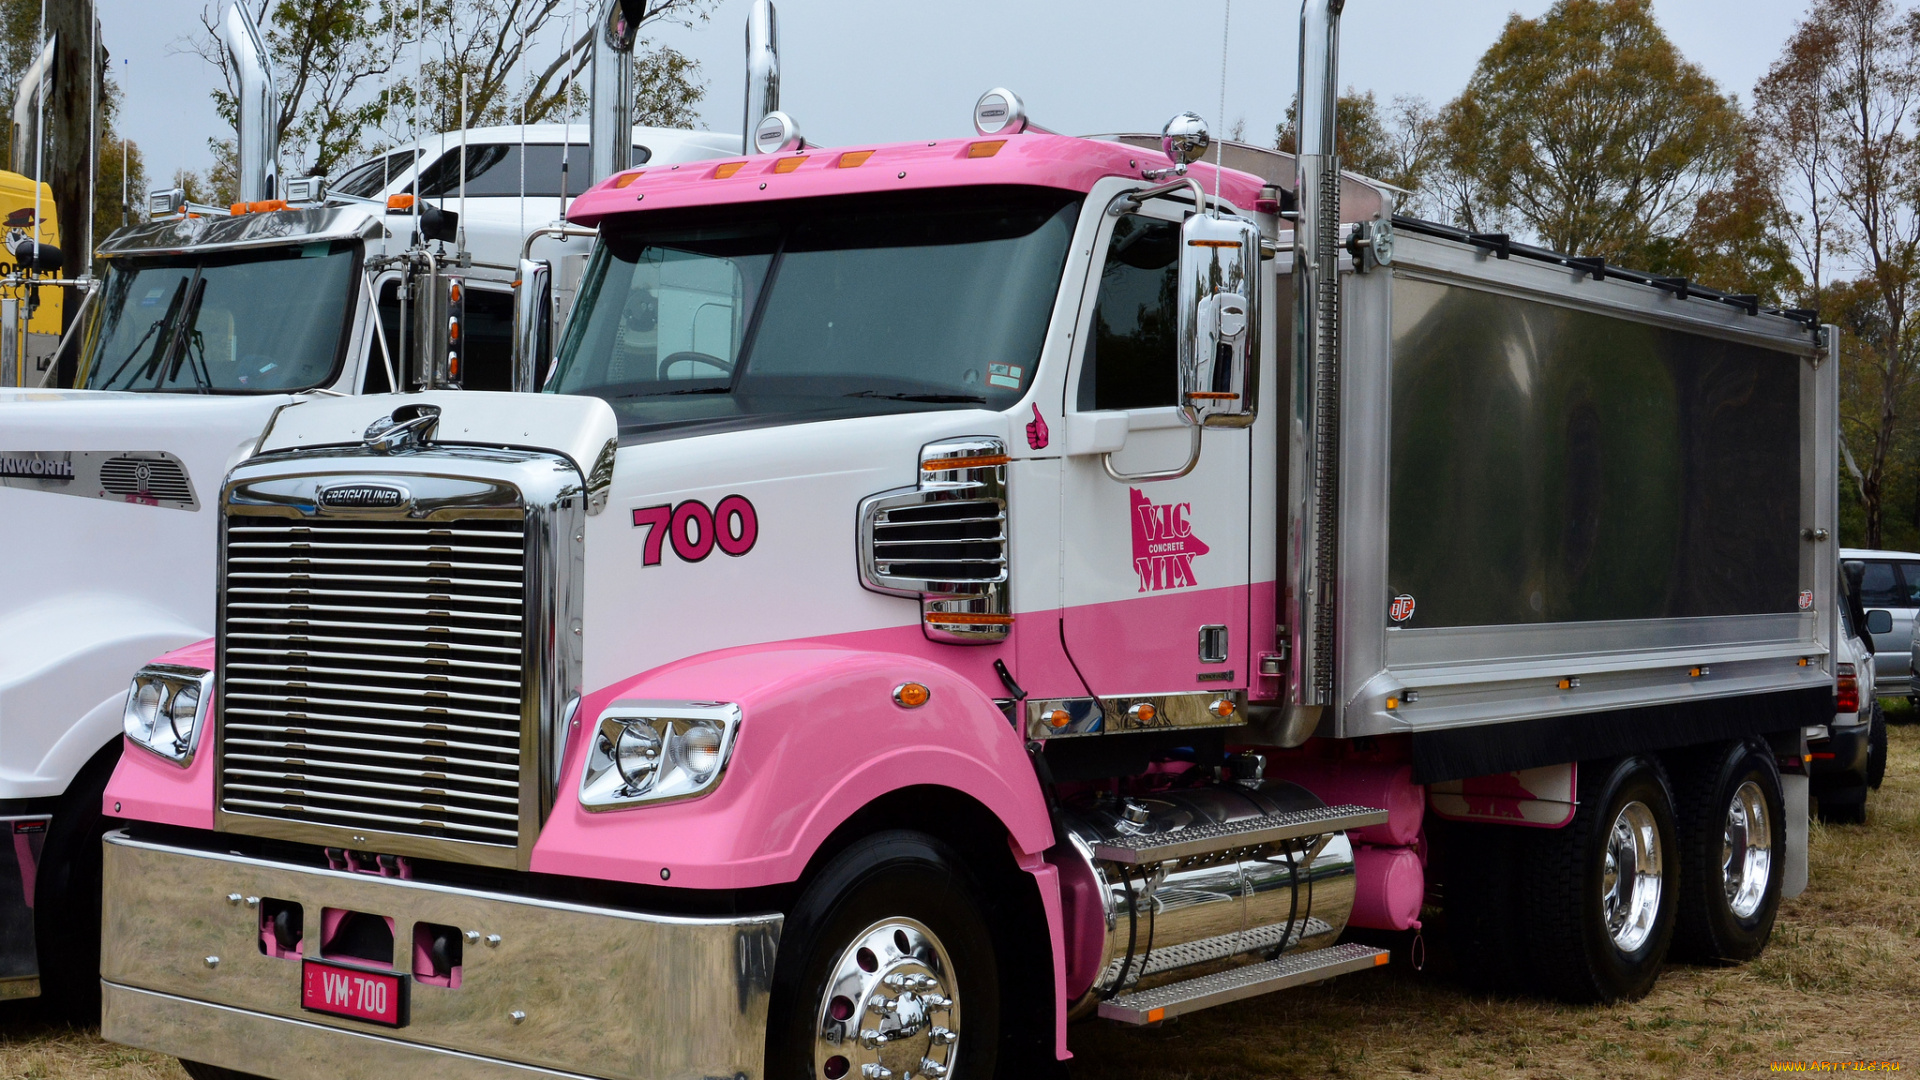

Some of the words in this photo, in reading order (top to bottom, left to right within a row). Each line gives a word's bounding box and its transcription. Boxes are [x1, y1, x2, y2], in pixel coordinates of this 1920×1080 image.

[0, 458, 74, 476] NWORTH
[326, 489, 398, 503] FREIGHTLINER
[630, 494, 758, 568] 700
[1138, 502, 1191, 540] VIC
[1149, 541, 1184, 553] CONCRETE
[1136, 552, 1197, 592] MIX
[306, 972, 314, 998] VIC
